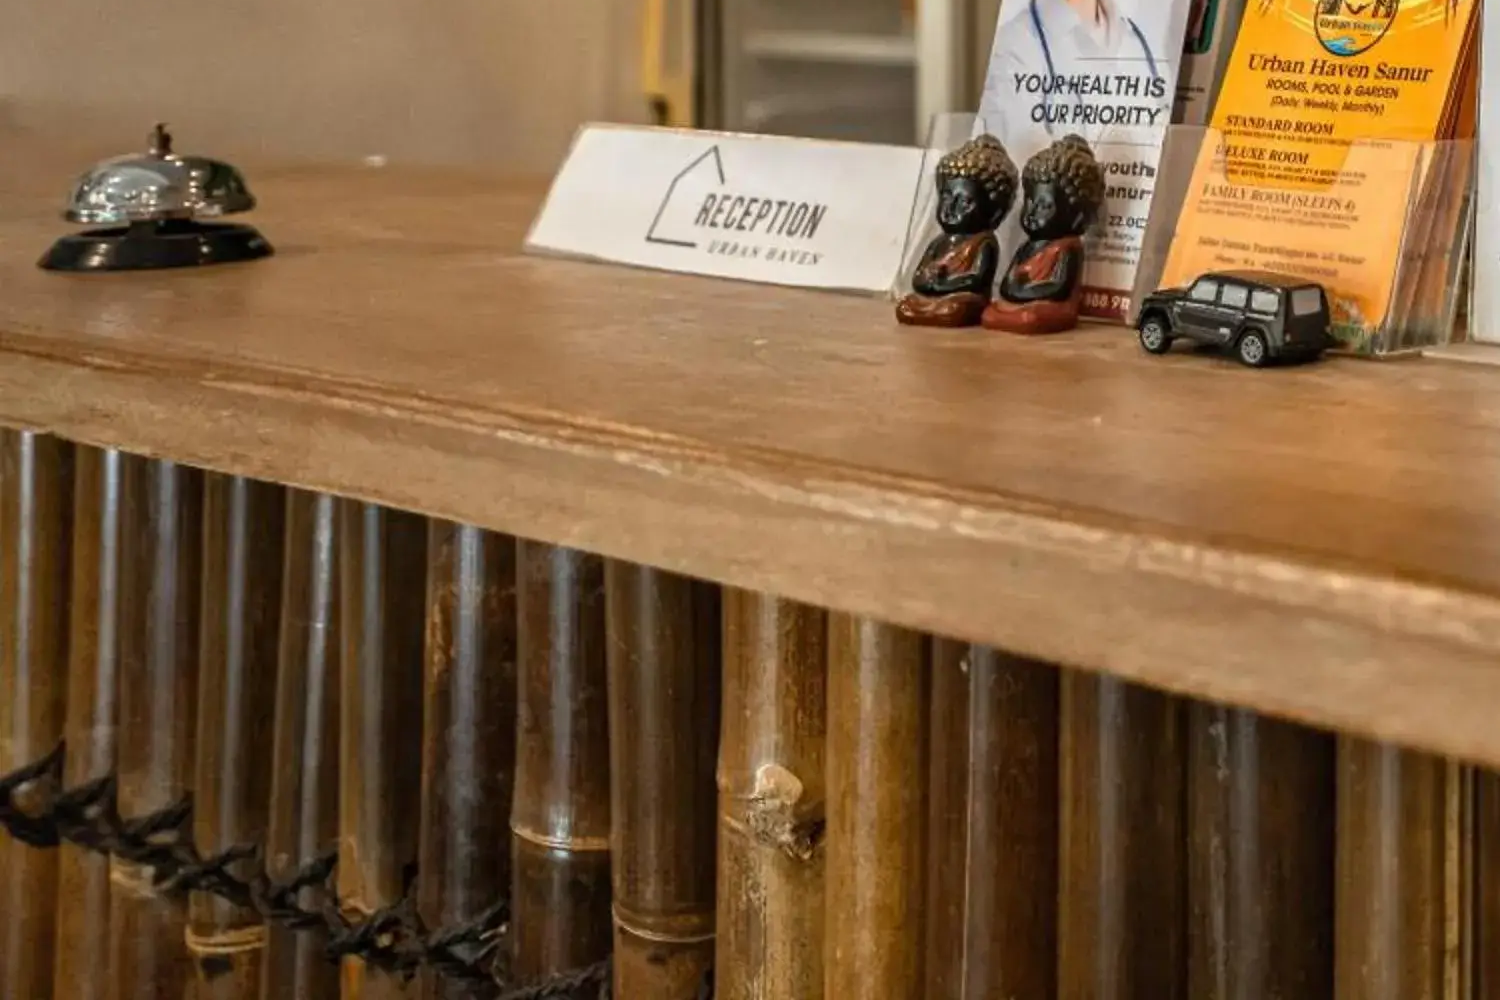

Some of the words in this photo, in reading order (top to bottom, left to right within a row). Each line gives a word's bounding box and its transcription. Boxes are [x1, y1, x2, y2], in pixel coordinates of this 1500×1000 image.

[1248, 53, 1305, 74] Urban
[1309, 58, 1370, 79] Haven
[1374, 62, 1434, 82] Sanur
[1014, 73, 1066, 94] YOUR
[1068, 75, 1139, 96] HEALTH
[1144, 75, 1166, 98] IS
[1312, 82, 1340, 95] POOL
[1355, 85, 1399, 100] GARDEN
[1031, 103, 1069, 123] OUR
[1072, 104, 1162, 125] PRIORITY
[1225, 115, 1291, 134] STANDARD
[1293, 120, 1334, 135] ROOM
[1215, 143, 1267, 160] DELUXE
[1269, 150, 1309, 165] ROOM
[1202, 183, 1248, 199] FAMILY
[1250, 189, 1291, 205] ROOM
[694, 193, 828, 239] RECEPTION
[707, 240, 762, 258] URBAN
[765, 246, 824, 265] HAVEN
